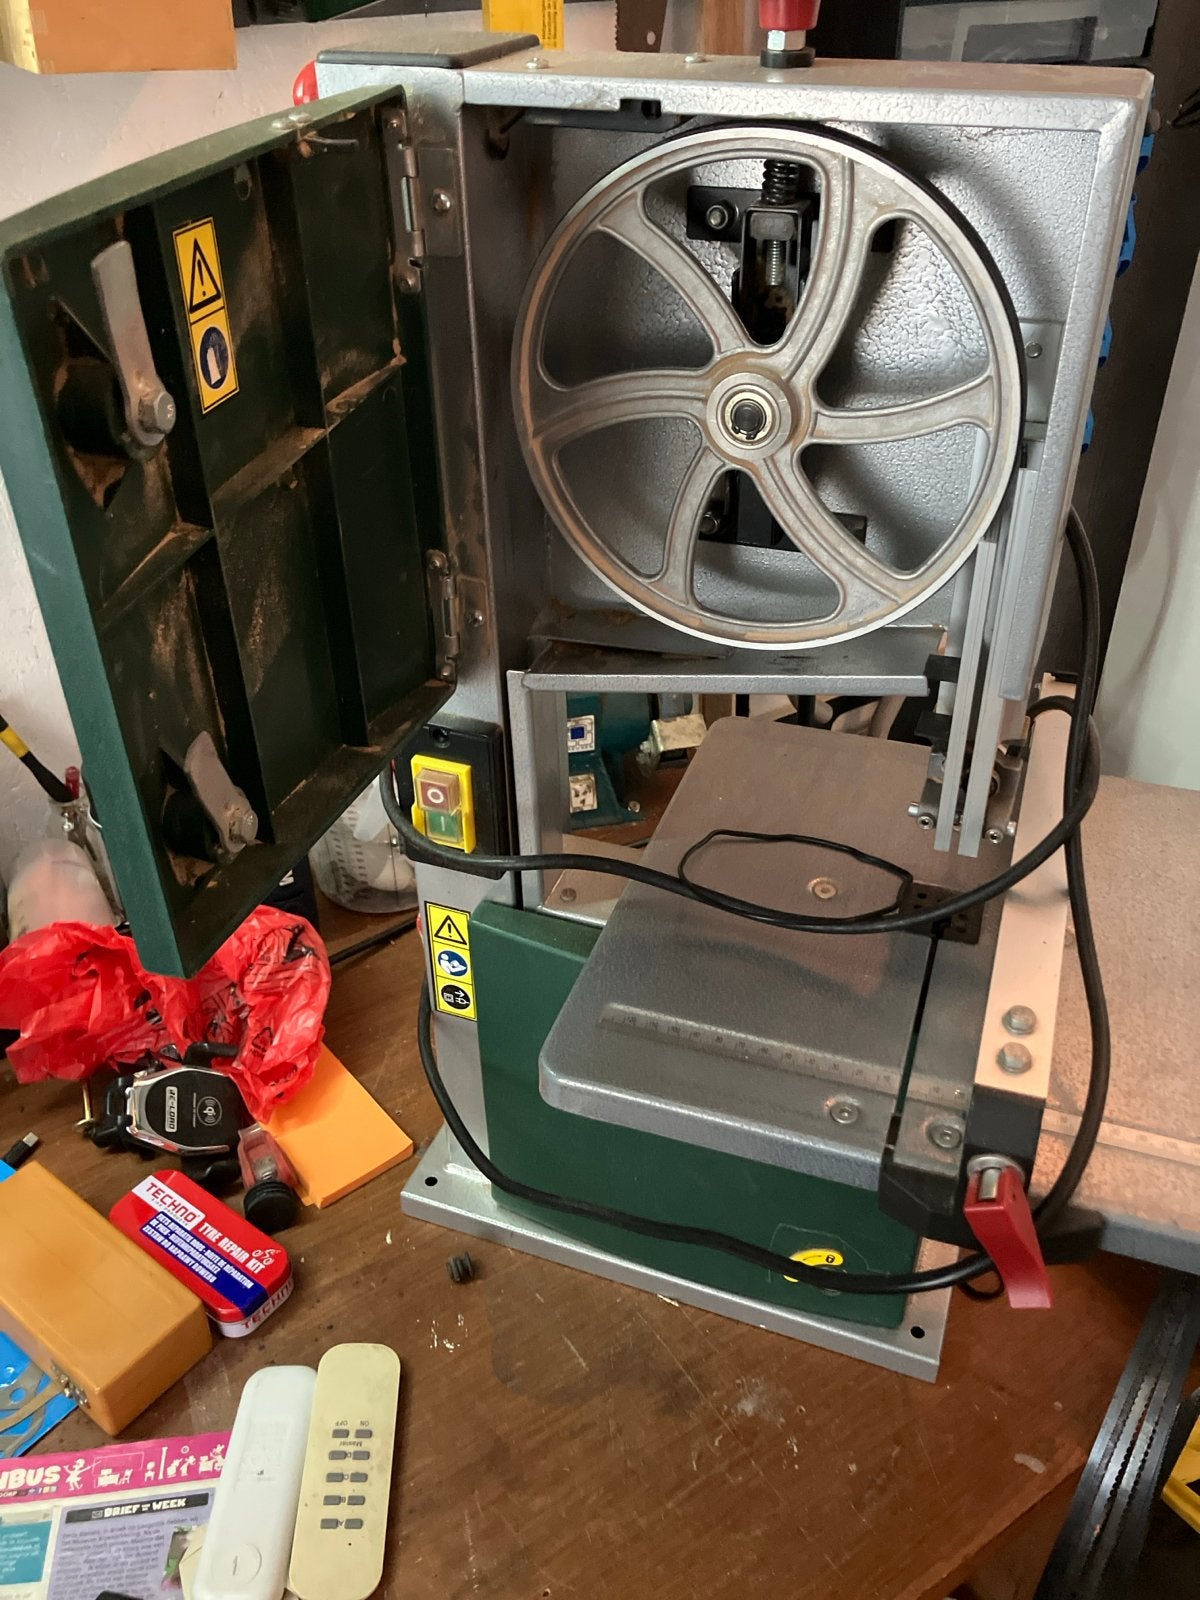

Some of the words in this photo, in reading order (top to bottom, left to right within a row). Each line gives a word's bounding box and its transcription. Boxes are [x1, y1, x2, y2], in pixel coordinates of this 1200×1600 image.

[146, 1182, 197, 1223] TECHNO
[198, 1222, 223, 1243] TYRE
[217, 1237, 250, 1264] REPAIR
[245, 1258, 266, 1275] KIT
[103, 1503, 141, 1518] BRIEF
[152, 1498, 187, 1511] WEEK
